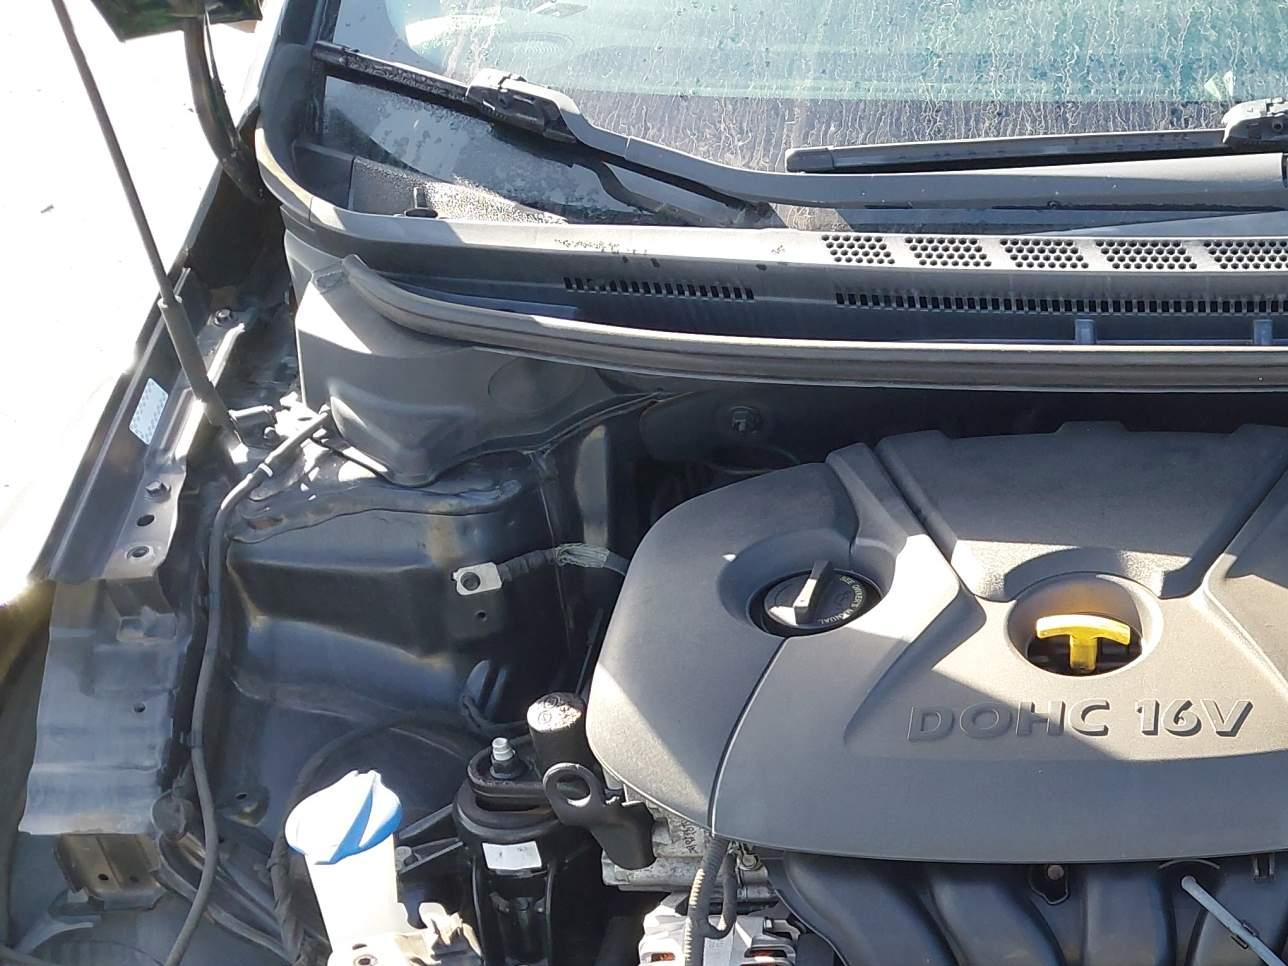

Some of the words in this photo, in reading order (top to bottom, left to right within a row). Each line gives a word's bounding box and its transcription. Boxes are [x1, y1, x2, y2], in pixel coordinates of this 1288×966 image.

[840, 576, 856, 585] SEE
[818, 608, 854, 624] MANUAL
[907, 700, 1110, 742] DOHC
[1134, 699, 1253, 738] 16V
